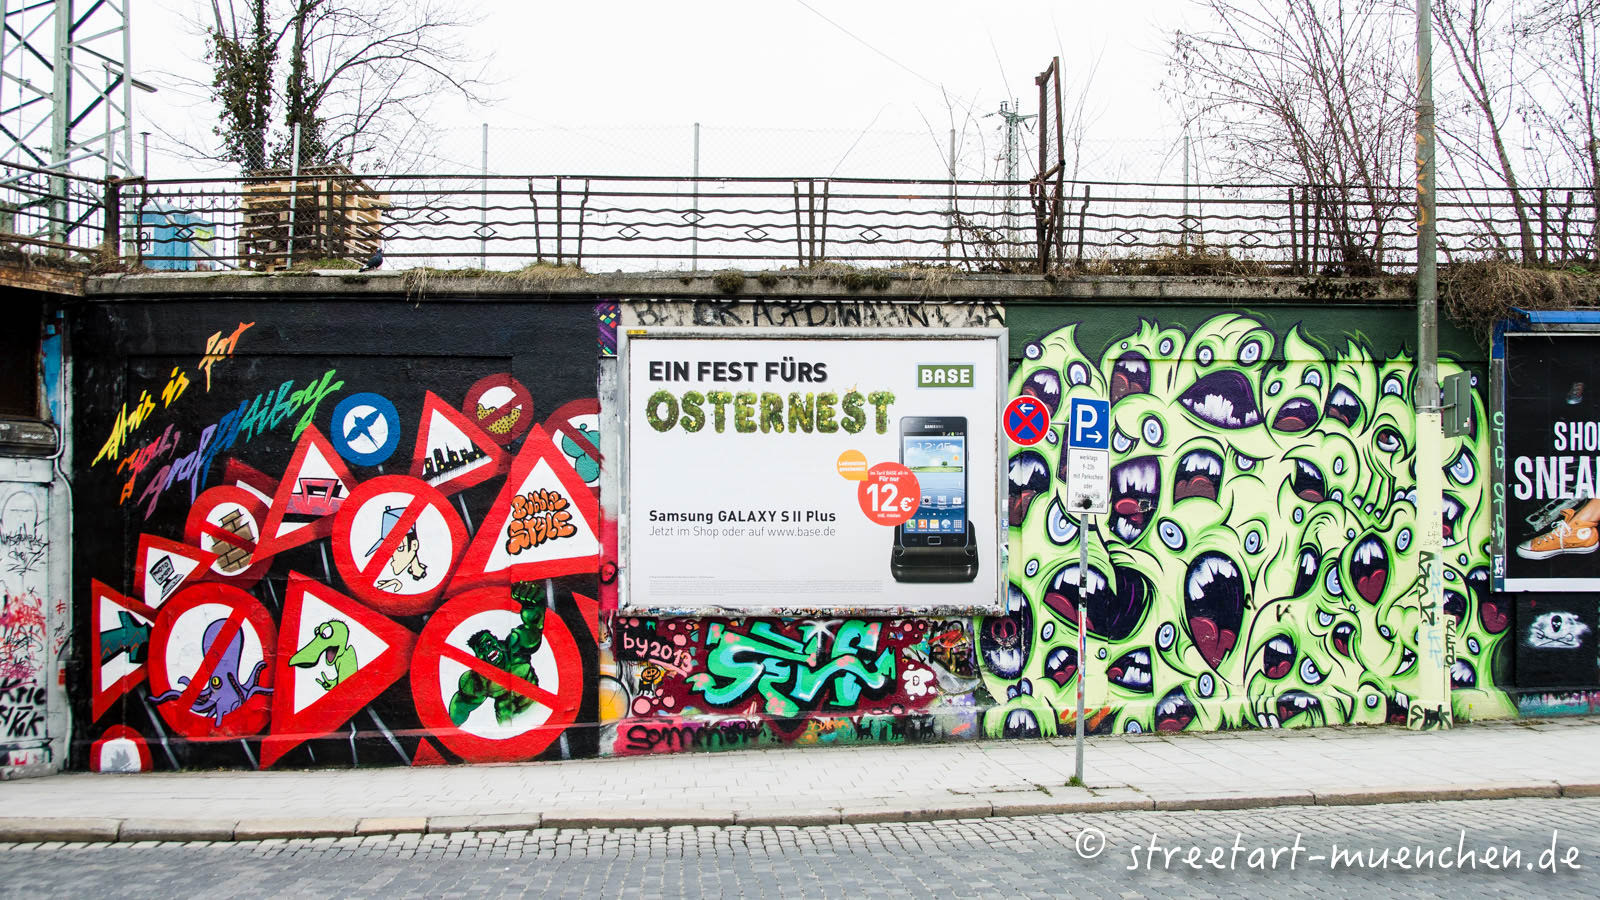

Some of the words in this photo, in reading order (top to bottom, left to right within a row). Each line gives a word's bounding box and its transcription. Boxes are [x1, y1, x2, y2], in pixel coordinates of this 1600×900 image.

[649, 361, 691, 383] EIN
[697, 361, 759, 383] FEST
[765, 356, 829, 383] FÜRS
[921, 368, 970, 384] BASE
[645, 387, 896, 435] OSTERNEST
[1075, 403, 1098, 442] P
[1553, 421, 1600, 451] SHO
[1514, 455, 1600, 501] SNEA
[511, 487, 571, 521] Bubble
[649, 510, 713, 525] Samsung
[718, 510, 777, 522] GALAXY
[781, 510, 790, 522] S
[793, 510, 801, 522] II
[806, 510, 836, 522] Plus
[649, 526, 674, 537] Jetzt
[677, 526, 690, 537] im
[693, 526, 719, 539] Shop
[722, 526, 745, 537] oder
[749, 526, 765, 537] auf
[767, 526, 836, 537] www.base.de
